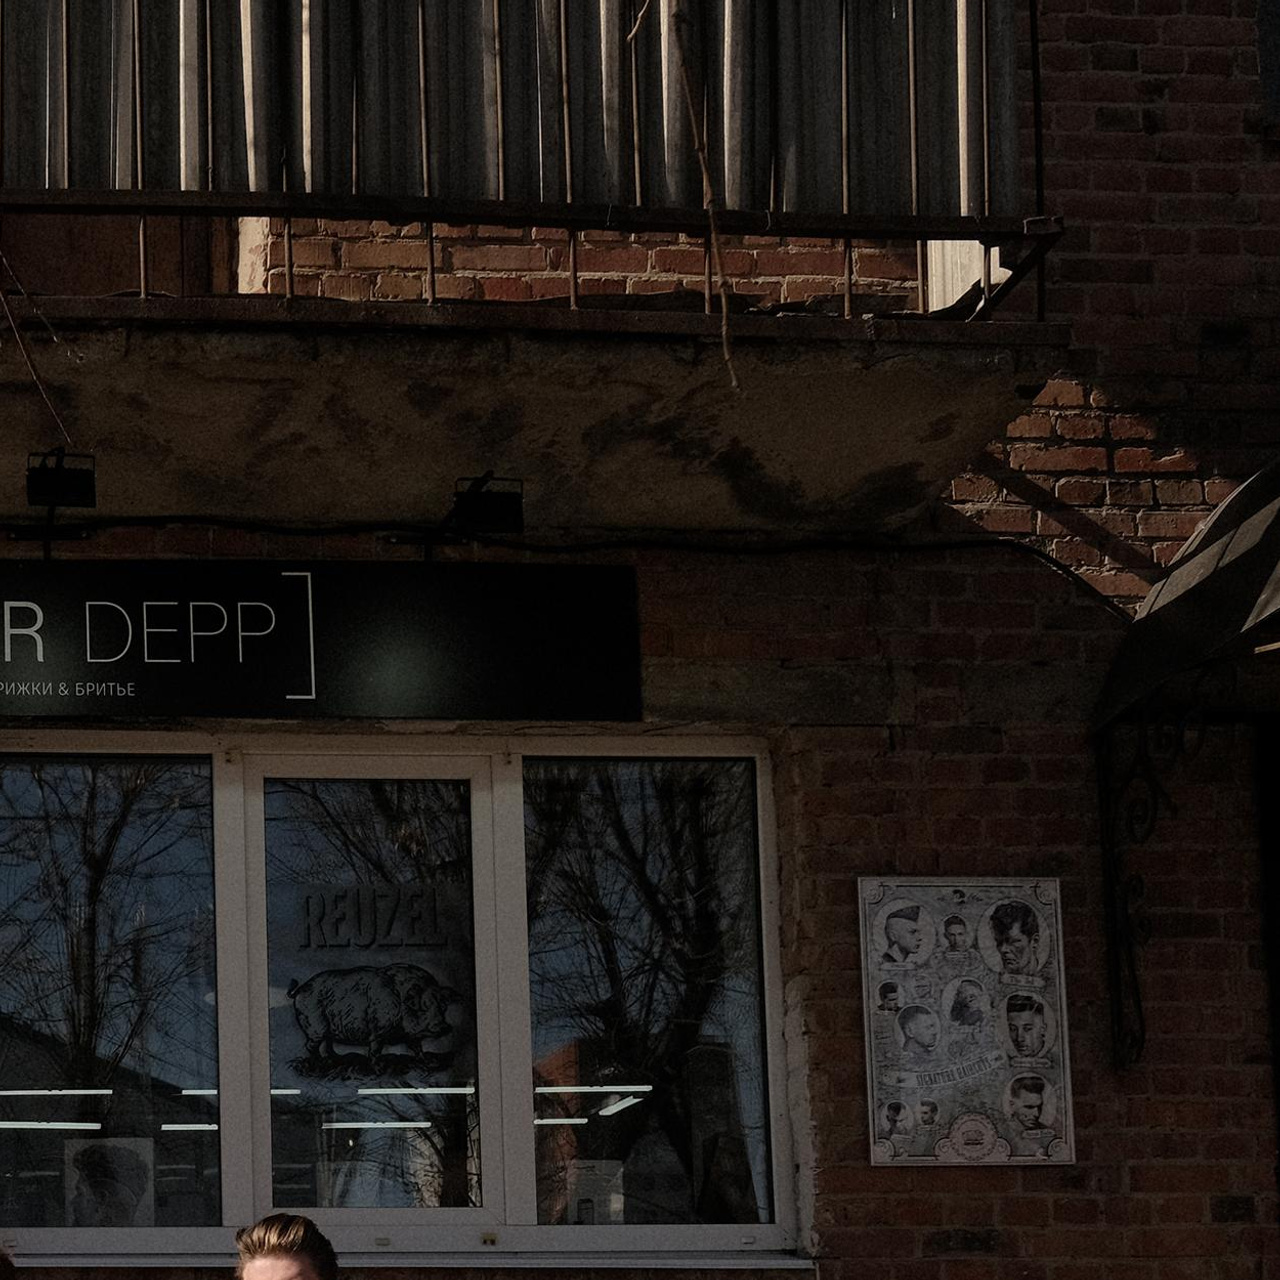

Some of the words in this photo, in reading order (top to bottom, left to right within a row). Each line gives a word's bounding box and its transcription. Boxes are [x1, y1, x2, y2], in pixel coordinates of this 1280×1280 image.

[84, 601, 277, 664] DEPP
[58, 682, 69, 696] &
[75, 682, 136, 697] БРИТЬЕ
[297, 885, 450, 950] REUZEL
